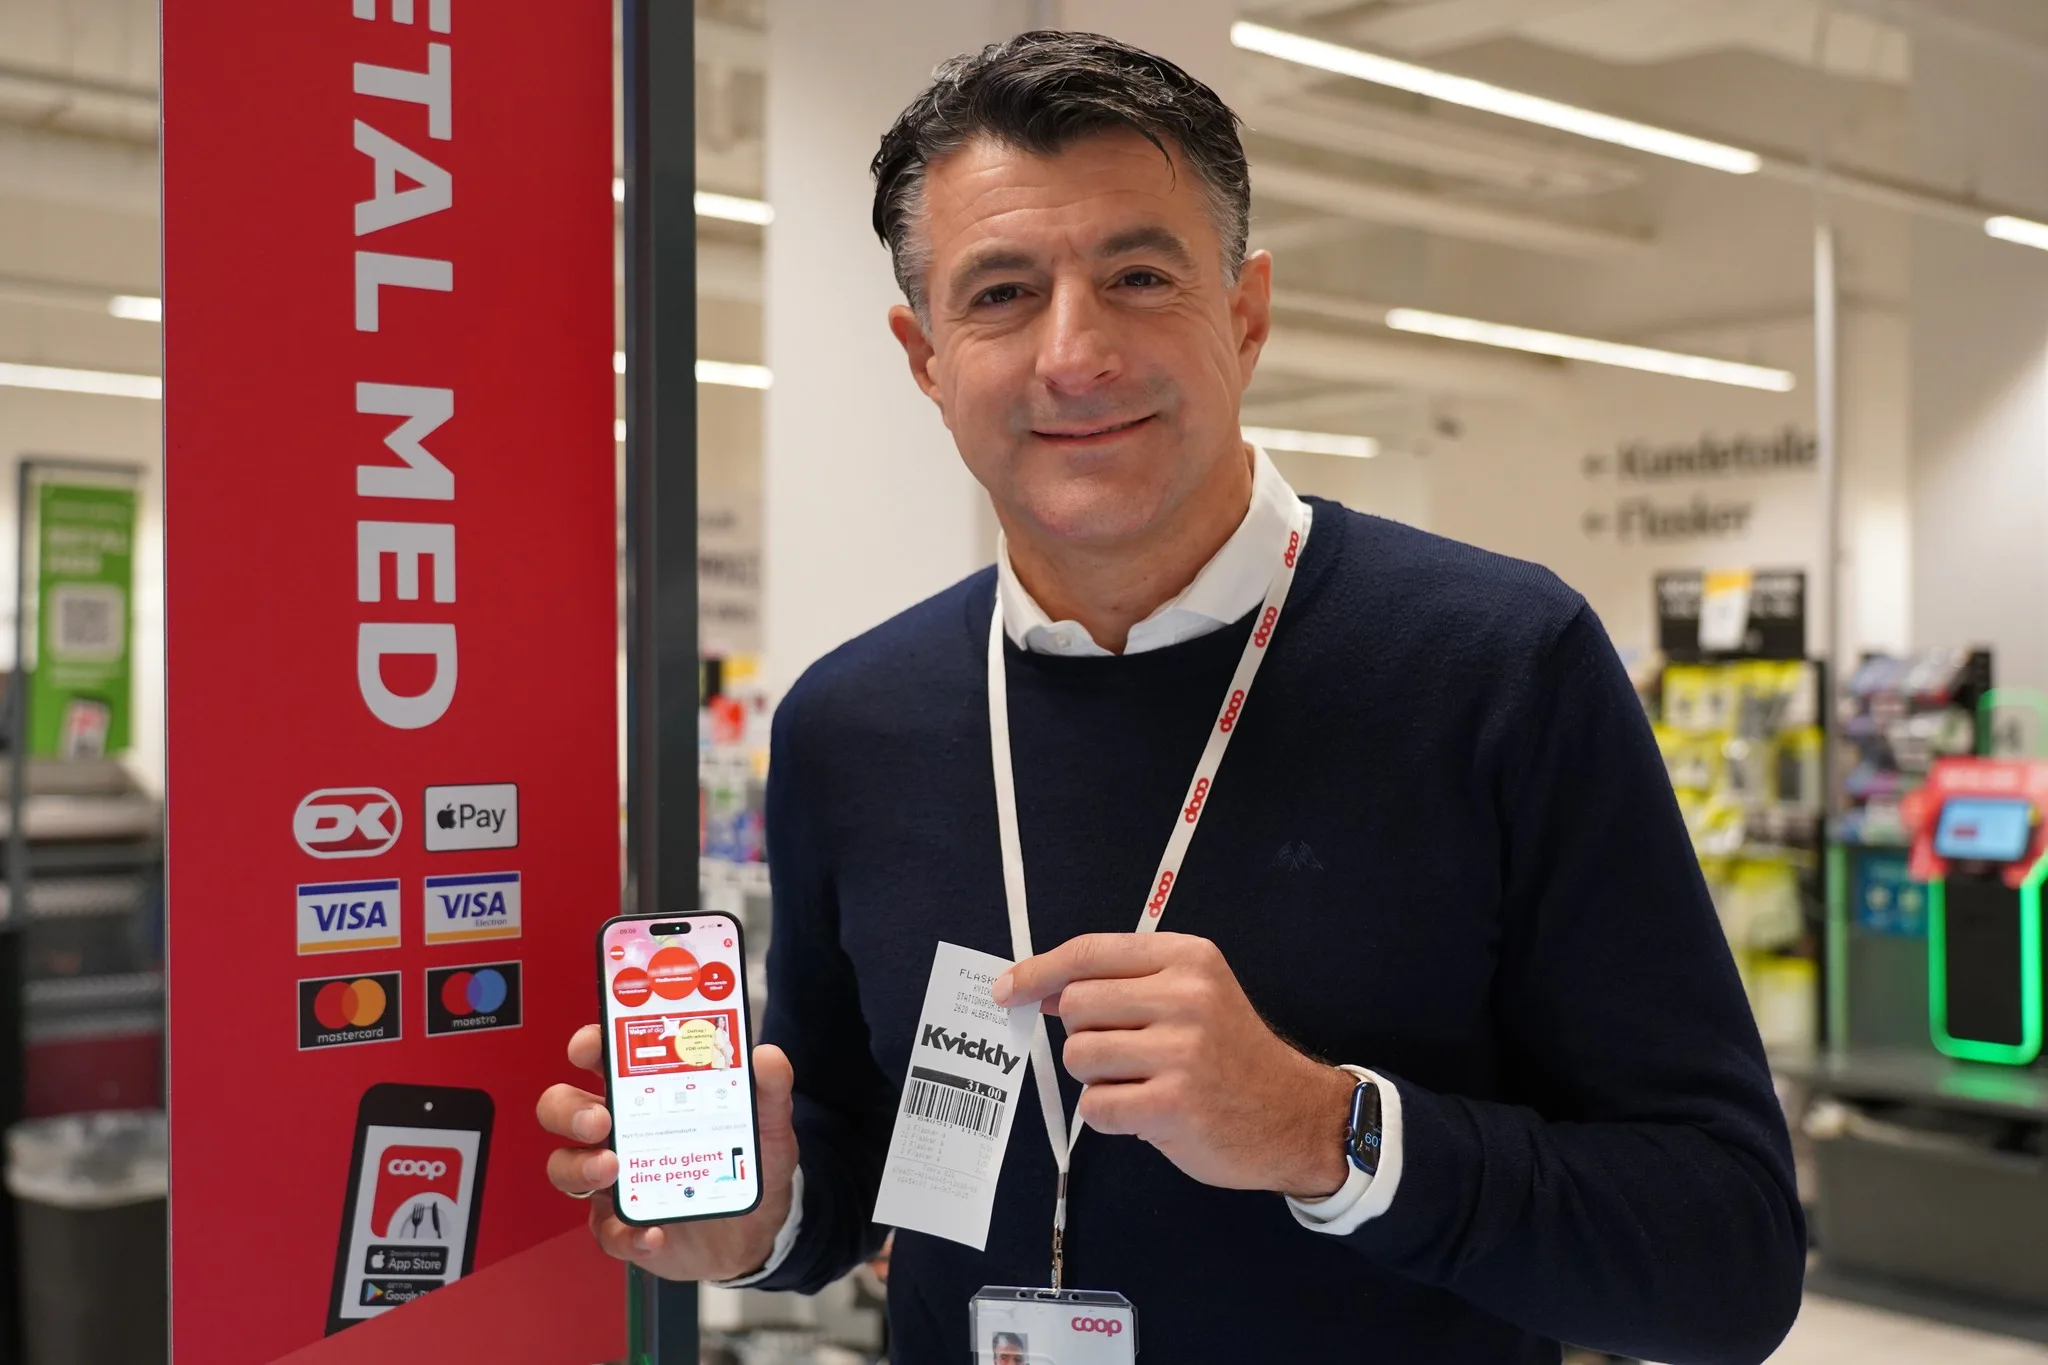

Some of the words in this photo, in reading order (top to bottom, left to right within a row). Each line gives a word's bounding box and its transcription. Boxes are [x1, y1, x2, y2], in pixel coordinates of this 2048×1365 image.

[355, 381, 458, 730] MED
[1284, 531, 1299, 568] coop
[1254, 606, 1277, 648] coop
[1219, 689, 1245, 733] coop
[1184, 777, 1210, 824] coop
[459, 803, 506, 834] Pay
[1149, 870, 1174, 918] coop
[309, 900, 388, 932] VISA
[437, 891, 507, 920] VISA
[475, 917, 508, 928] Electron
[959, 969, 998, 984] FLASK
[452, 1015, 497, 1029] maestro
[629, 1027, 647, 1037] Valgt
[653, 1025, 665, 1035] dig
[317, 1026, 385, 1045] mastercard
[921, 1024, 1021, 1075] Kvickly
[966, 1080, 1002, 1101] 31.00
[388, 1158, 446, 1180] coop
[629, 1157, 656, 1169] Har
[659, 1154, 677, 1166] du
[681, 1150, 724, 1167] glemt
[630, 1171, 662, 1184] dine
[665, 1168, 710, 1183] penge
[388, 1258, 411, 1271] App
[412, 1258, 442, 1270] Store
[385, 1289, 419, 1303] Google
[1071, 1316, 1123, 1337] coop
